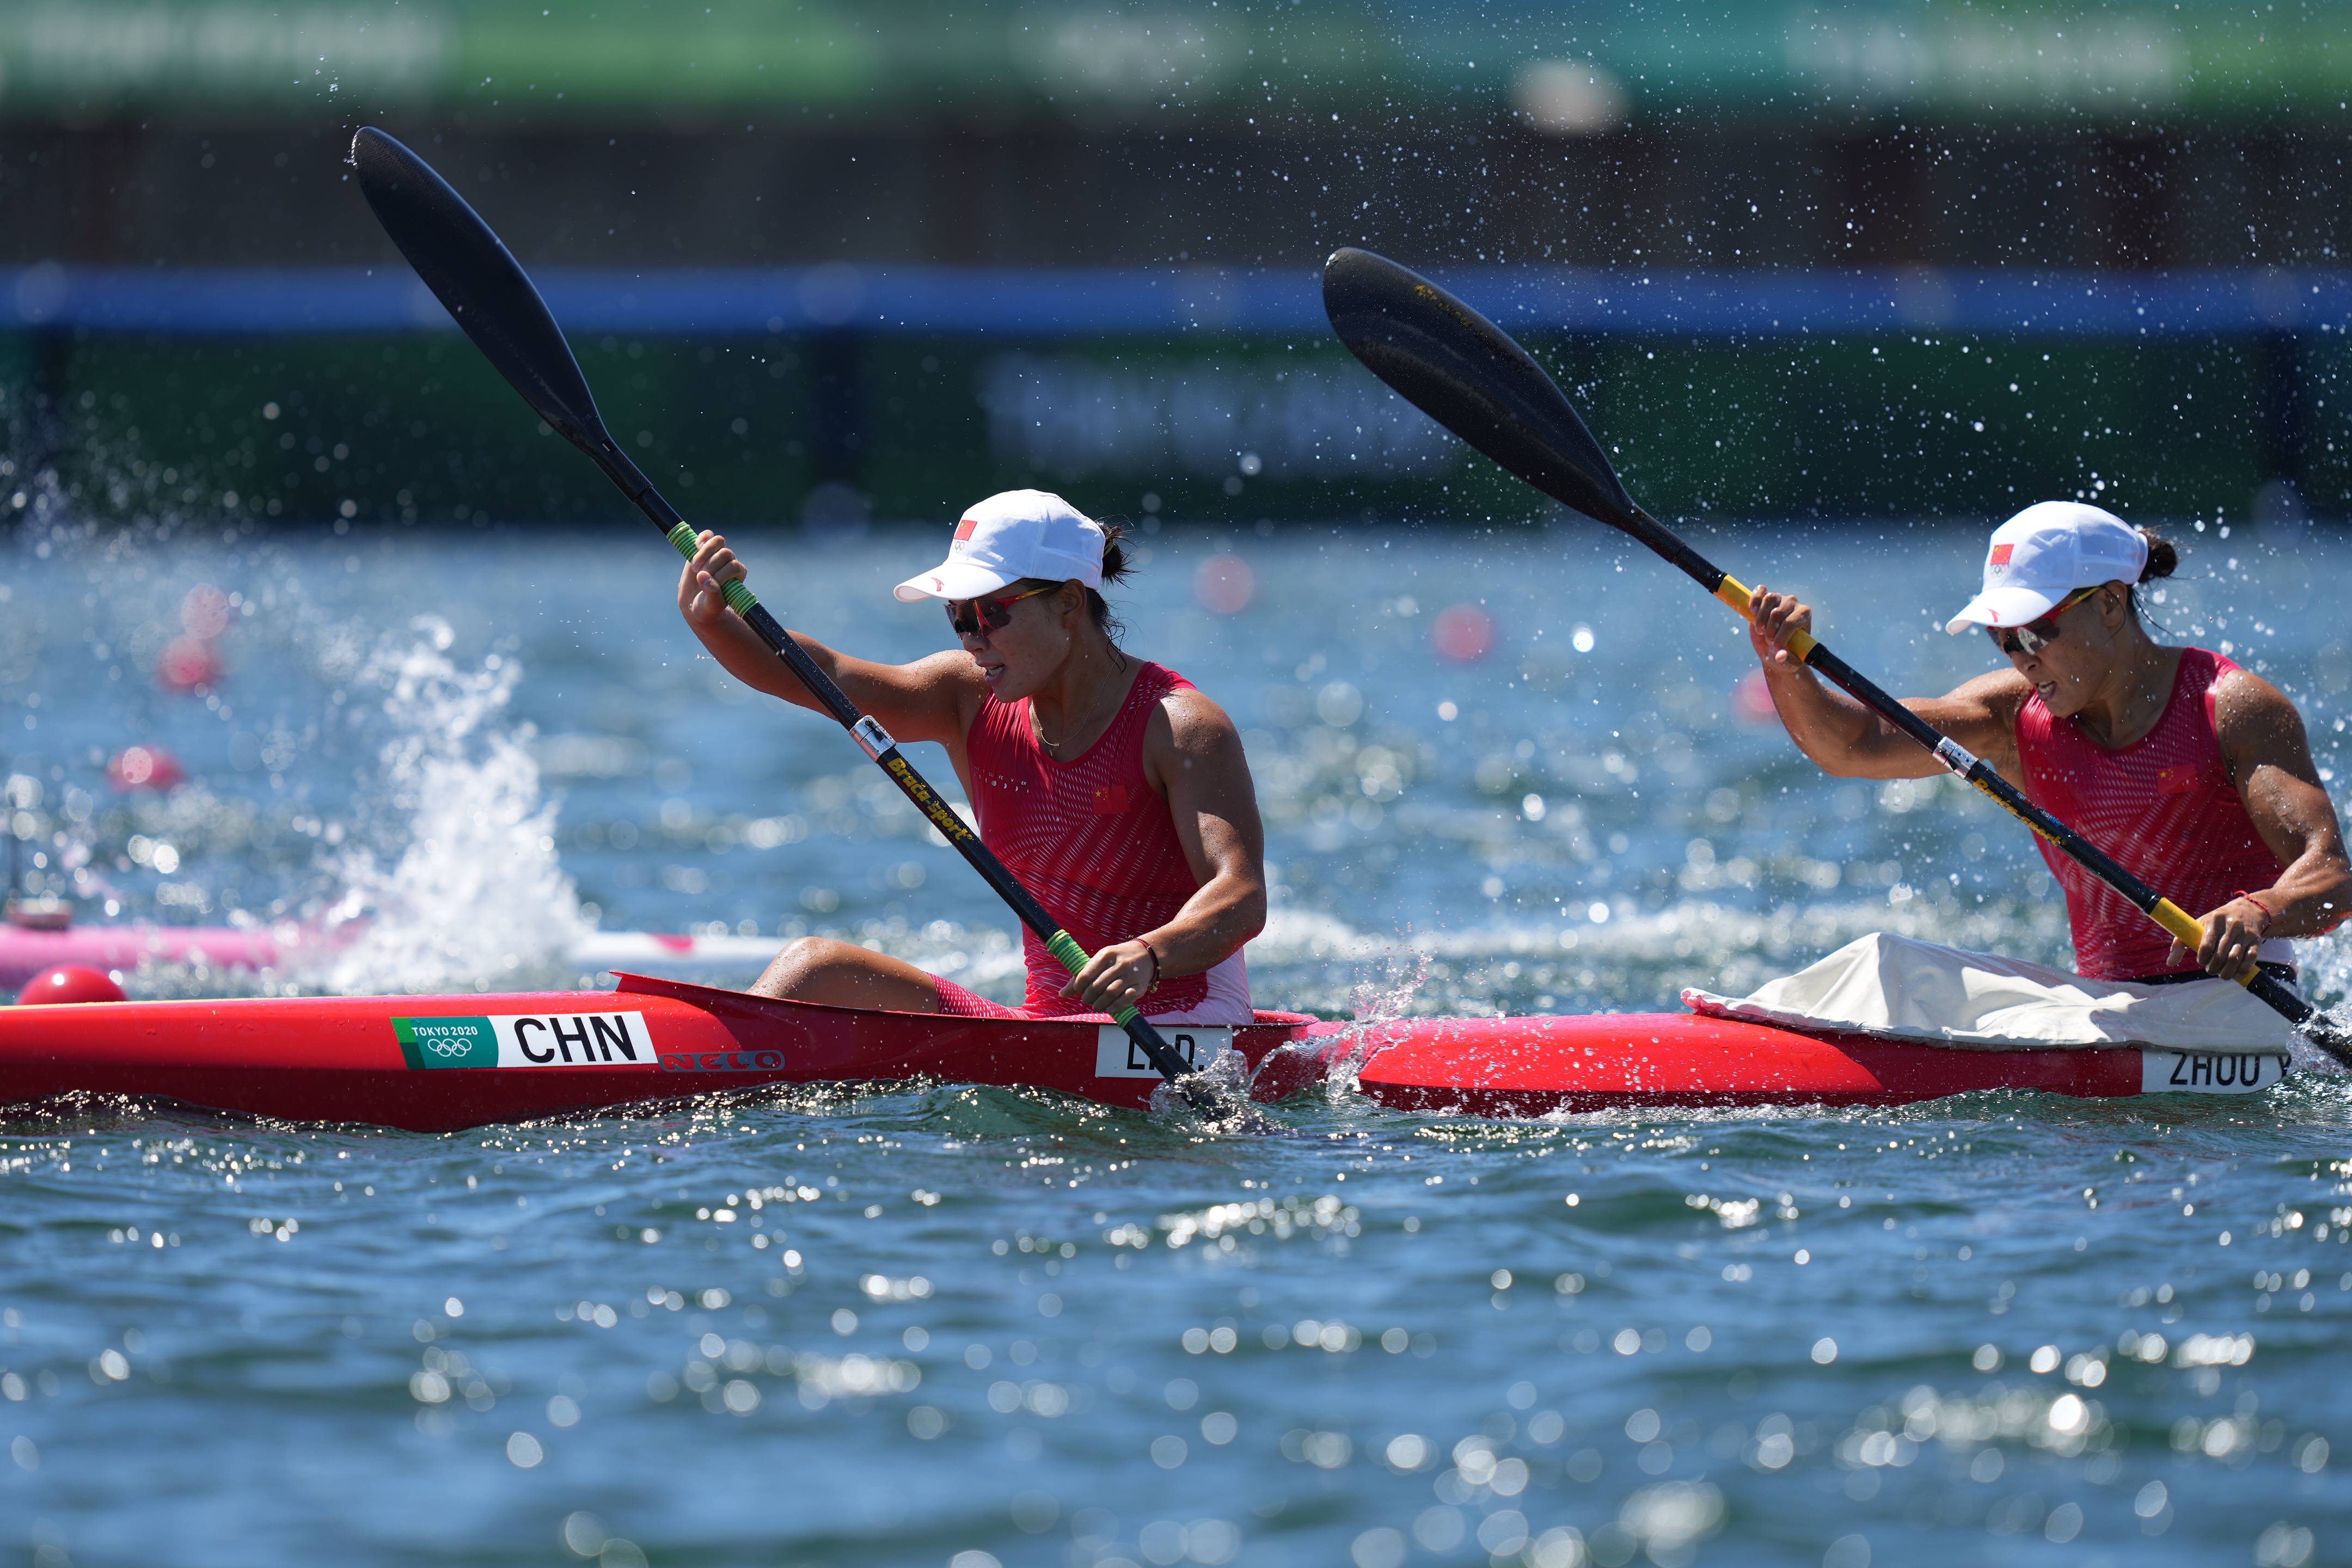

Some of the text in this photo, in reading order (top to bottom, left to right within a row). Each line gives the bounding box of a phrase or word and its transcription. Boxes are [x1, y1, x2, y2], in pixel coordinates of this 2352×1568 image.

[411, 1026, 478, 1036] TOKYO 2020
[513, 1015, 638, 1063] CHN
[665, 1051, 782, 1071] NELO
[2170, 1051, 2261, 1087] ZHOU
